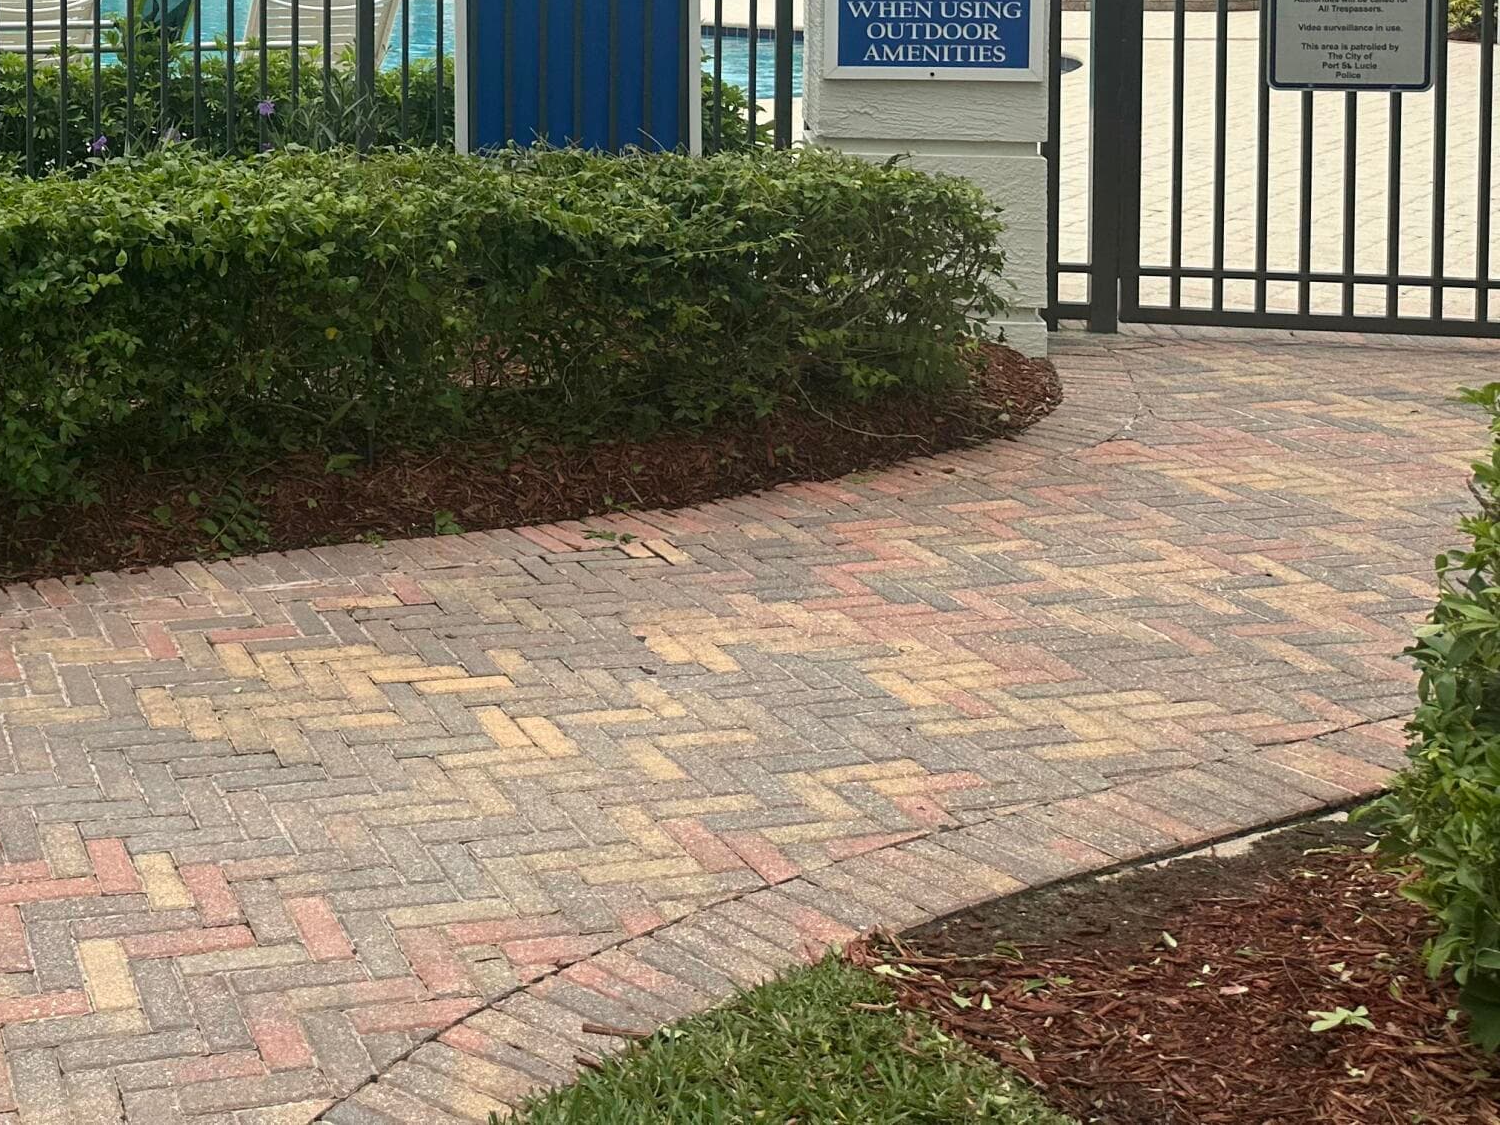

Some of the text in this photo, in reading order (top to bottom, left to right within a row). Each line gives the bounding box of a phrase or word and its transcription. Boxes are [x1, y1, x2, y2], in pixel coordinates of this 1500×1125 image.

[847, 1, 1021, 19] WHEN USING
[866, 22, 1001, 40] OUTDOOR
[863, 45, 1006, 62] AMENITIES
[1351, 43, 1386, 51] patrolled
[1389, 43, 1399, 51] by
[1345, 53, 1361, 61] City
